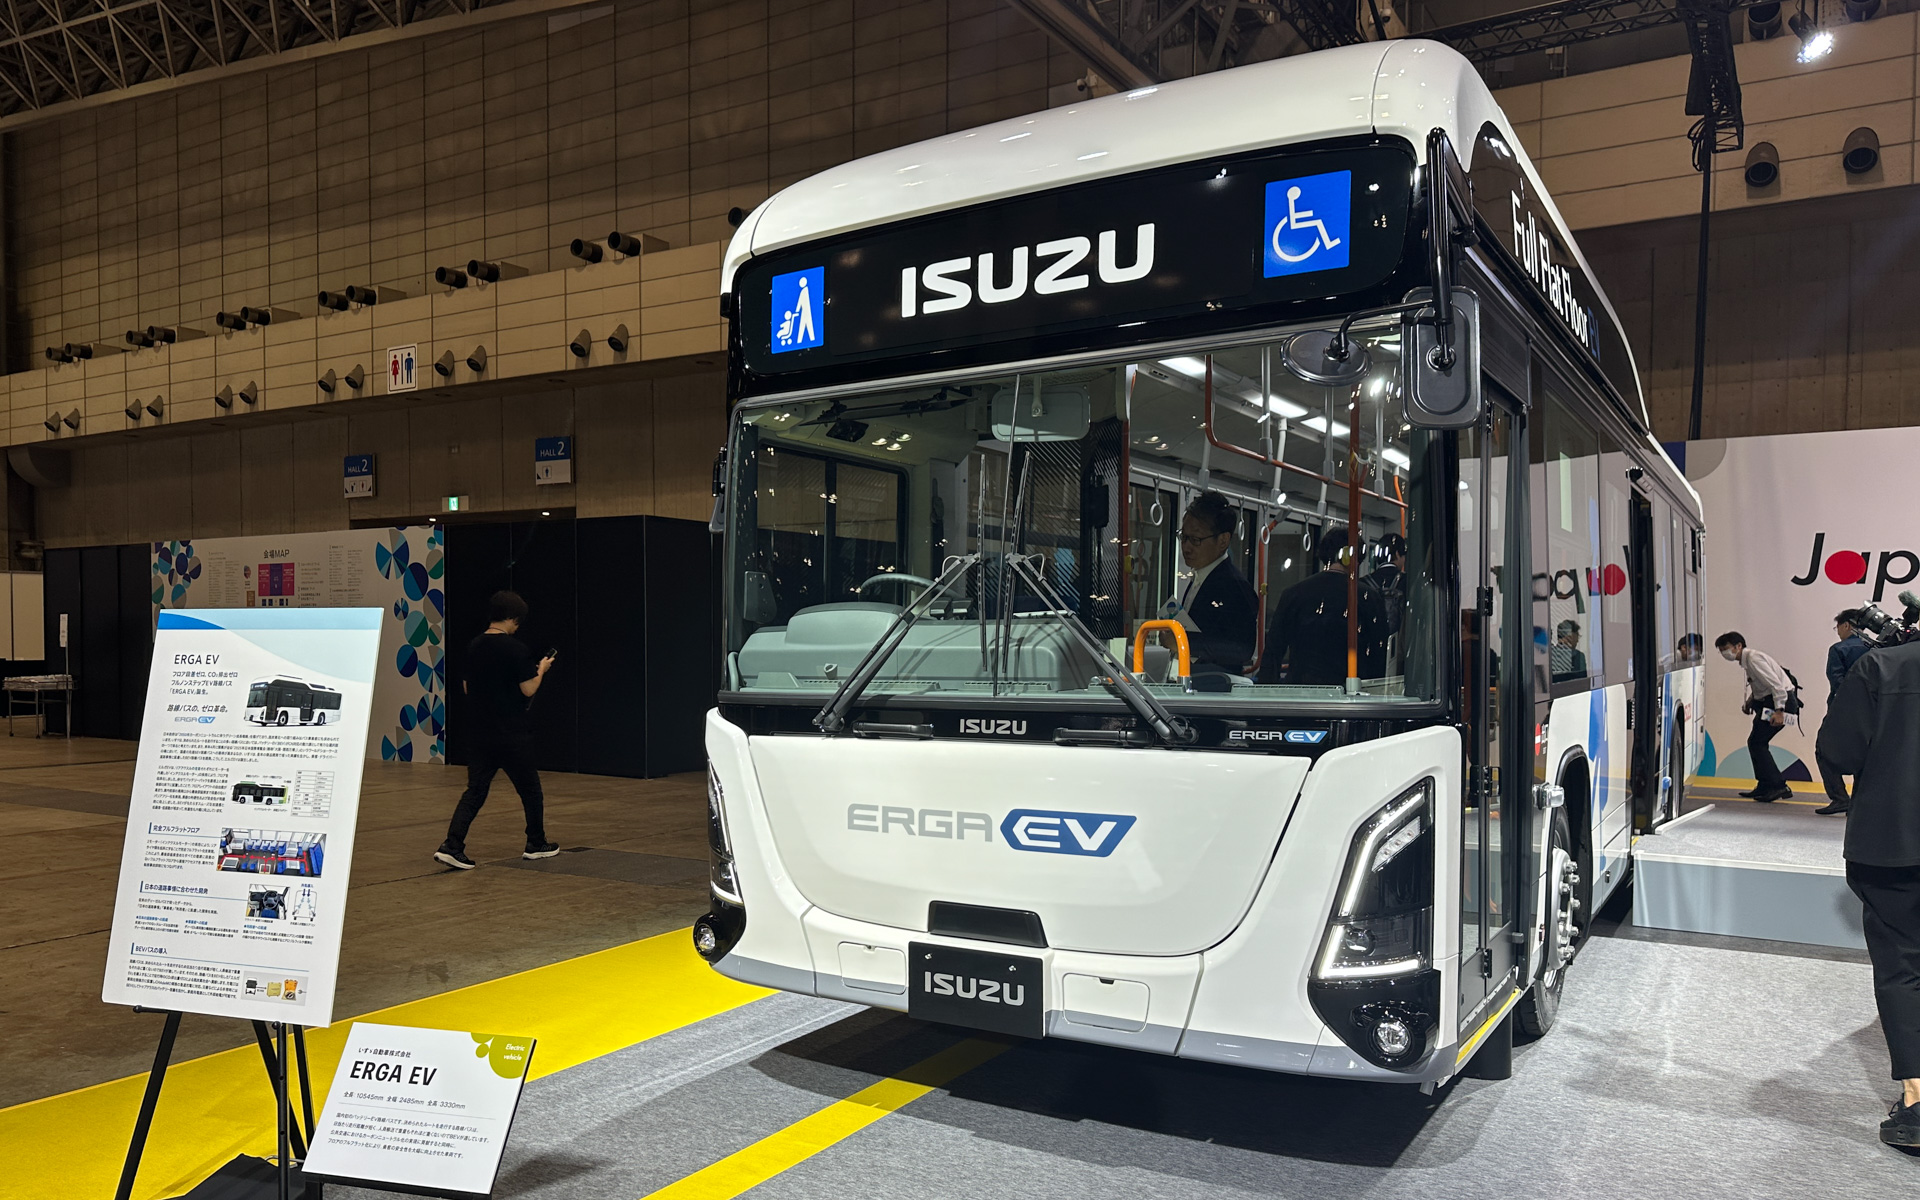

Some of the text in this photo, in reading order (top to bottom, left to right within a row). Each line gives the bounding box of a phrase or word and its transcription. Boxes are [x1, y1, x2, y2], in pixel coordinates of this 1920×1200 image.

[901, 222, 1155, 318] ISUZU
[1511, 190, 1539, 284] Full
[1538, 231, 1564, 316] Flat
[1561, 266, 1589, 348] Floor
[539, 441, 565, 458] HALL 2
[347, 458, 368, 473] HALL 2
[173, 654, 220, 665] ERGA EV
[959, 717, 1028, 736] ISUZU
[1228, 729, 1323, 744] ERGA EV
[847, 803, 1120, 853] ERGA EV
[924, 970, 1025, 1007] ISUZU
[505, 1043, 525, 1052] Electric
[503, 1053, 523, 1061] vehicle
[349, 1060, 437, 1086] ERGA EV
